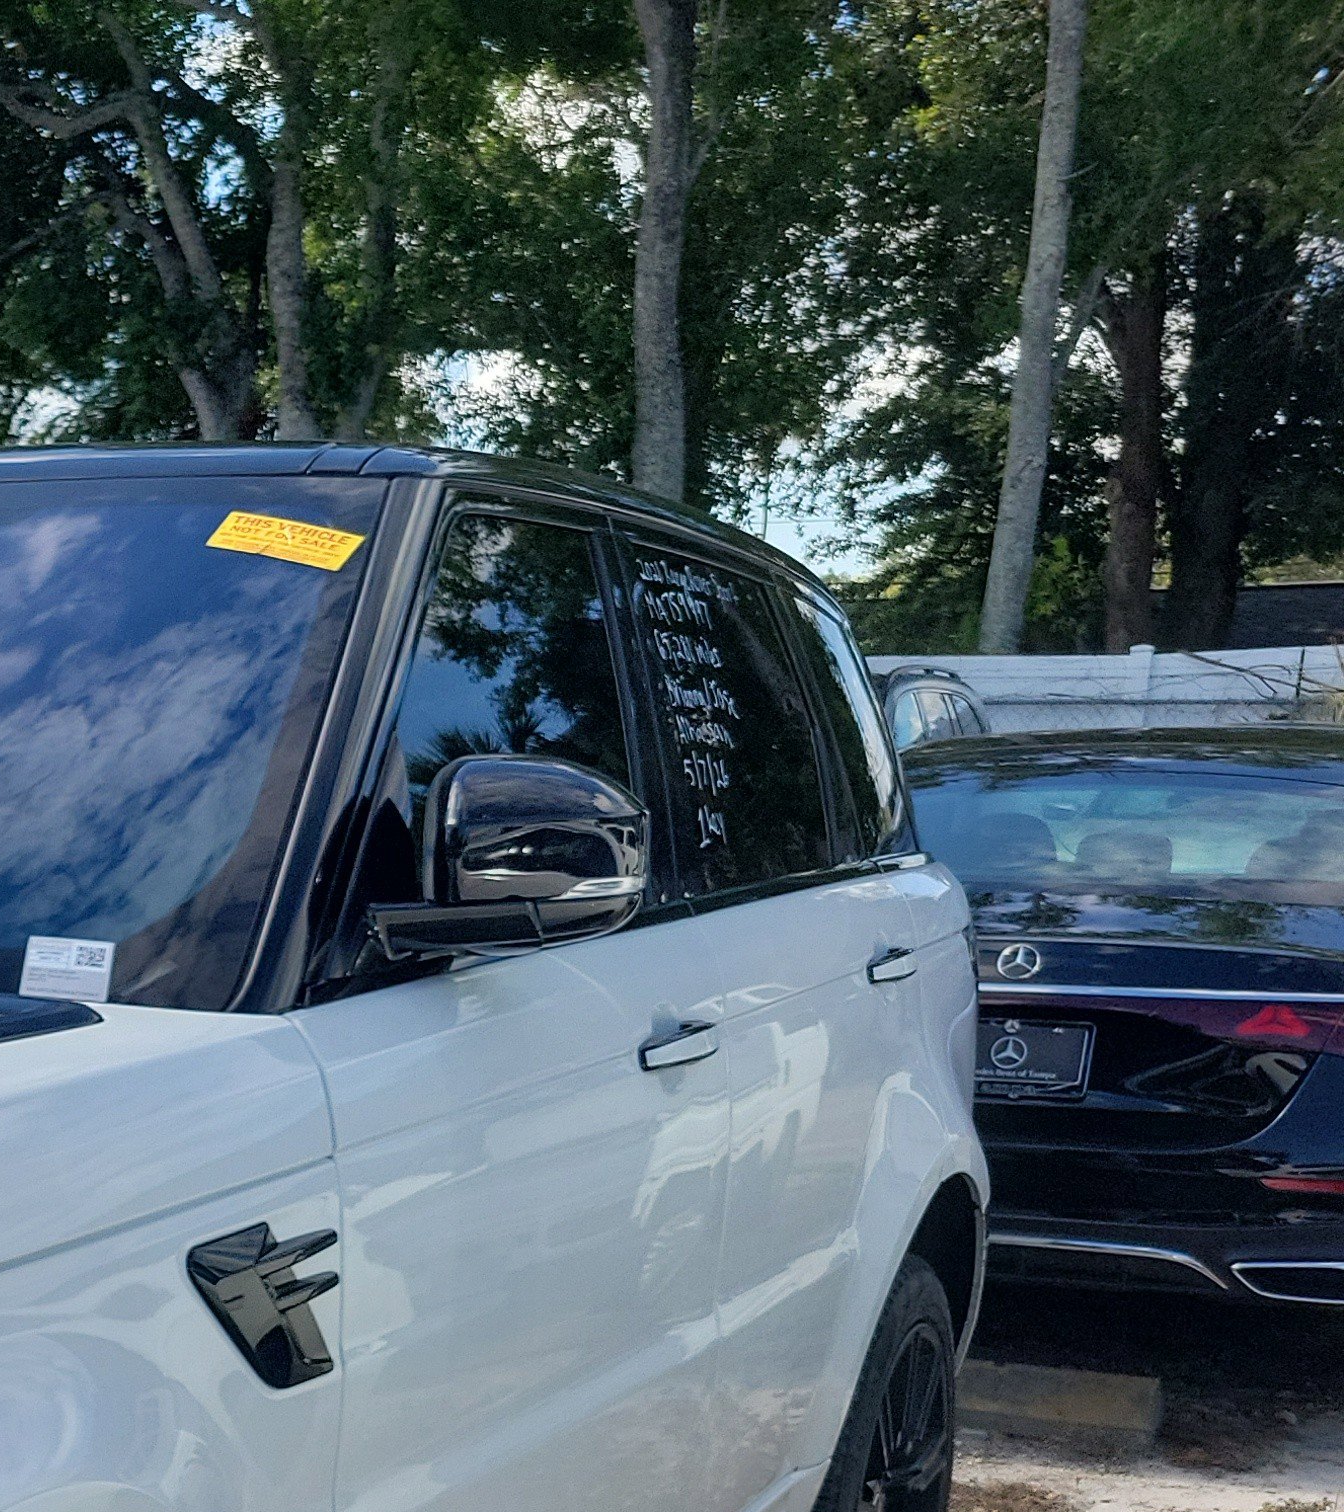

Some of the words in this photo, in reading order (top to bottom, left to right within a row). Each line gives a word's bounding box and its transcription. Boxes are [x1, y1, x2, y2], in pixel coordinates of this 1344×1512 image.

[230, 525, 258, 535] NOT
[233, 515, 274, 529] THIS
[279, 519, 352, 546] VEHICLE
